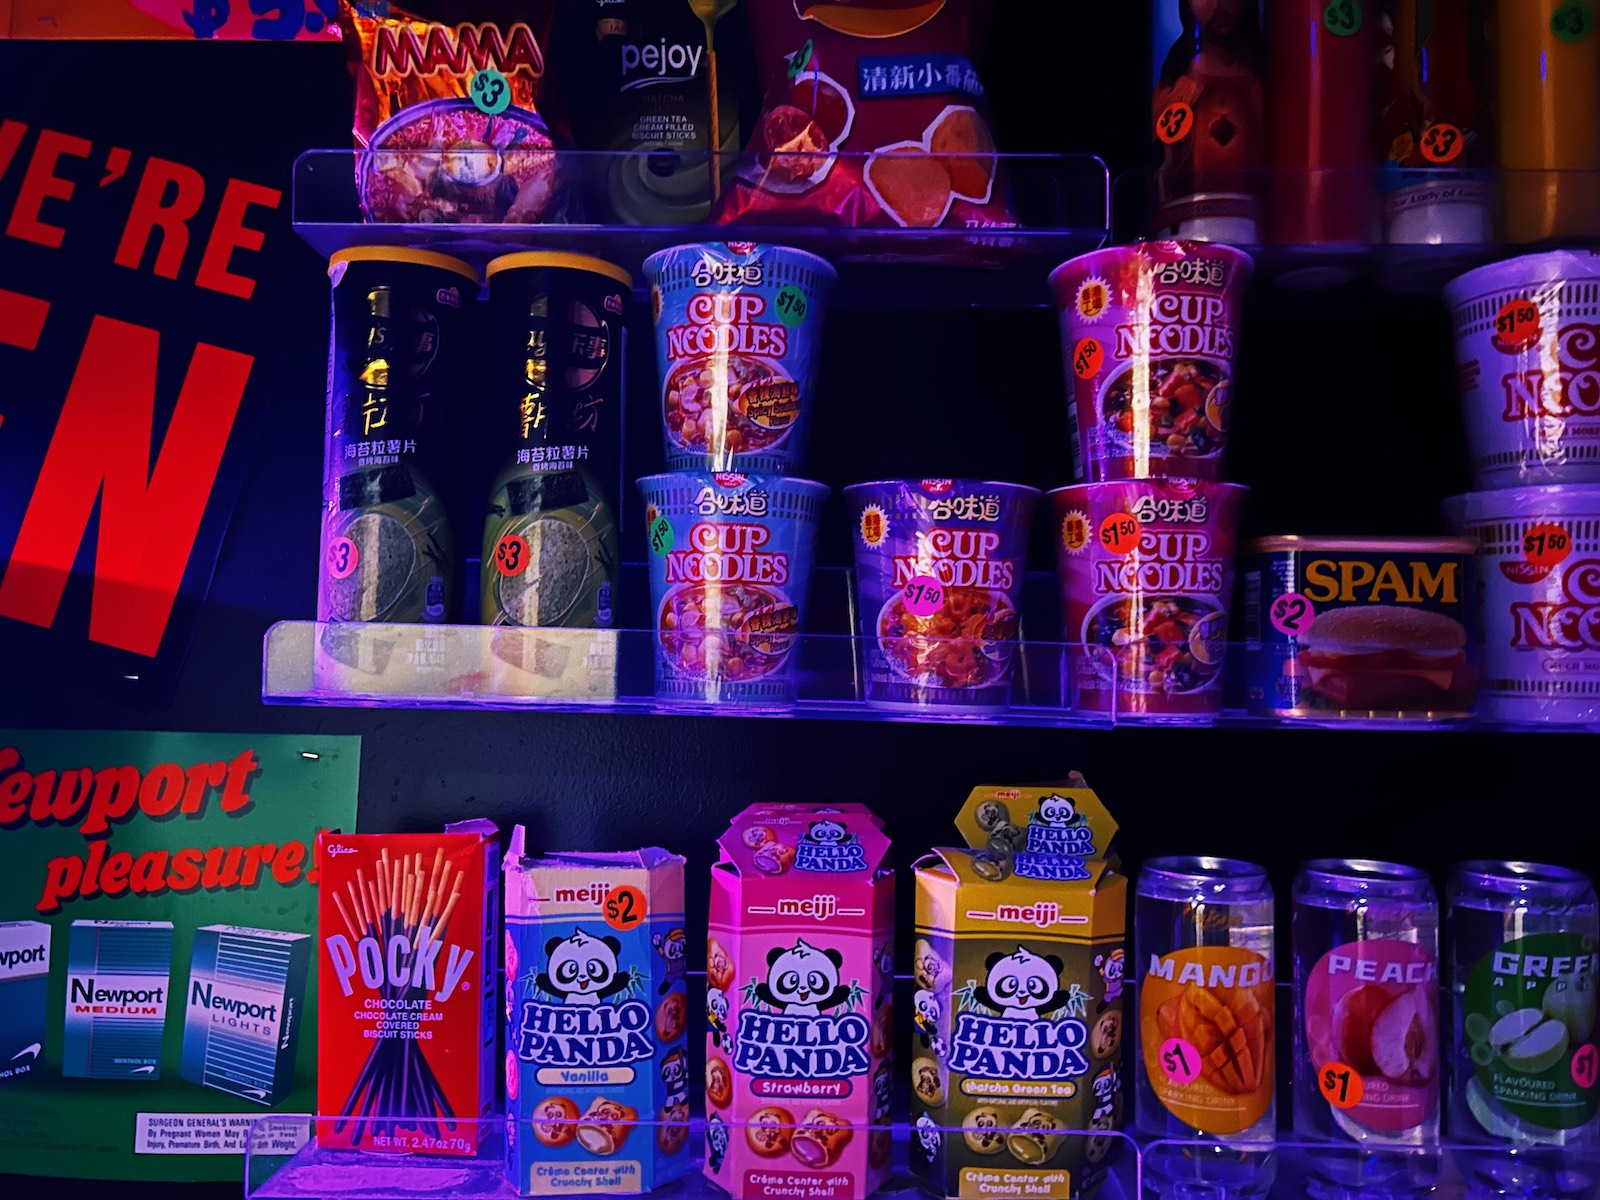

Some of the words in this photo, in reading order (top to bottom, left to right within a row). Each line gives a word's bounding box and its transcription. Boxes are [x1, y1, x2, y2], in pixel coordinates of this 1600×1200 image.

[372, 22, 545, 78] MAMA
[621, 37, 702, 76] pejoy
[474, 73, 505, 107] $3
[632, 123, 663, 131] CREAM
[665, 123, 694, 131] FILLED
[640, 115, 670, 123] GREEN
[671, 115, 688, 123] TEA
[1160, 108, 1187, 138] $3
[632, 132, 664, 140] BISCUIT
[666, 132, 697, 140] STICKS
[1424, 128, 1457, 157] $3
[691, 258, 765, 287] 合味道
[1155, 258, 1225, 287] 合味道
[688, 293, 766, 325] CUP
[1154, 294, 1225, 324] CUP
[668, 324, 787, 359] NOODLES
[1118, 324, 1235, 357] NOODLES
[344, 439, 417, 460] 海苔粒薯片
[516, 445, 590, 464] 海苔粒薯片
[715, 472, 747, 484] NISSIN
[694, 487, 768, 517] 合味道
[928, 494, 1001, 522] 合味道
[1131, 495, 1208, 523] 合味道
[691, 524, 769, 553] CUP
[926, 529, 1000, 560] CUP
[1136, 532, 1211, 561] CUP
[497, 541, 521, 571] $3
[667, 552, 789, 584] NOODLES
[1098, 561, 1222, 591] NOODLES
[1303, 559, 1459, 603] SPAM
[1506, 563, 1549, 577] NISSIN
[1273, 598, 1307, 631] $2
[0, 747, 257, 834] ewport
[997, 791, 1020, 799] meiji
[1028, 826, 1093, 842] HELLO
[797, 845, 864, 858] HELLO
[1027, 840, 1096, 856] PANDA
[795, 856, 867, 871] PANDA
[1014, 864, 1091, 880] PANDA
[556, 883, 609, 905] meiji
[607, 891, 637, 923] $2
[779, 895, 835, 919] meiji
[999, 903, 1058, 926] meiji
[71, 978, 163, 1007] Newport
[191, 980, 277, 1023] Newport
[364, 999, 432, 1010] CHOCOLATE
[75, 1005, 157, 1014] MEDIUM
[354, 1011, 409, 1021] CHOCOLATE
[410, 1012, 443, 1021] CREAM
[522, 1002, 650, 1035] HELLO
[212, 1014, 272, 1036] LIGHTS
[281, 997, 294, 1050] Newport
[363, 1029, 398, 1039] BISCUIT
[400, 1030, 433, 1040] STICKS
[376, 1021, 420, 1030] COVERED
[740, 1013, 869, 1046] HELLO
[958, 1015, 1087, 1049] HELLO
[519, 1031, 655, 1065] PANDA
[734, 1041, 871, 1077] PANDA
[950, 1043, 1089, 1078] PANDA
[1163, 1043, 1191, 1077] $1
[15, 1065, 31, 1075] BOX
[560, 1071, 609, 1083] Vanilla
[1576, 1051, 1593, 1082] $1
[762, 1082, 841, 1096] Strawberry
[1324, 1070, 1351, 1102] $1
[1493, 1073, 1556, 1090] FLAVOURED
[147, 1129, 157, 1138] By
[160, 1129, 192, 1139] Pregnant
[195, 1129, 220, 1138] Women
[225, 1129, 240, 1139] May
[148, 1118, 184, 1127] SURGEON
[187, 1118, 227, 1127] GENERAL'S
[168, 1140, 200, 1149] Premature
[224, 1140, 236, 1148] And
[373, 1136, 391, 1146] NET
[393, 1136, 410, 1147] WT.
[450, 1138, 471, 1153] 70g
[550, 1177, 592, 1188] Crunchy
[595, 1176, 622, 1186] Shell
[573, 1166, 610, 1176] Center
[613, 1164, 635, 1175] with
[787, 1176, 823, 1186] Center
[826, 1176, 849, 1187] with
[1003, 1173, 1039, 1184] Center
[1042, 1173, 1065, 1185] with
[763, 1186, 805, 1198] Crunchy
[809, 1186, 835, 1197] Shell
[979, 1183, 1021, 1195] Crunchy
[1025, 1183, 1050, 1194] Shell
